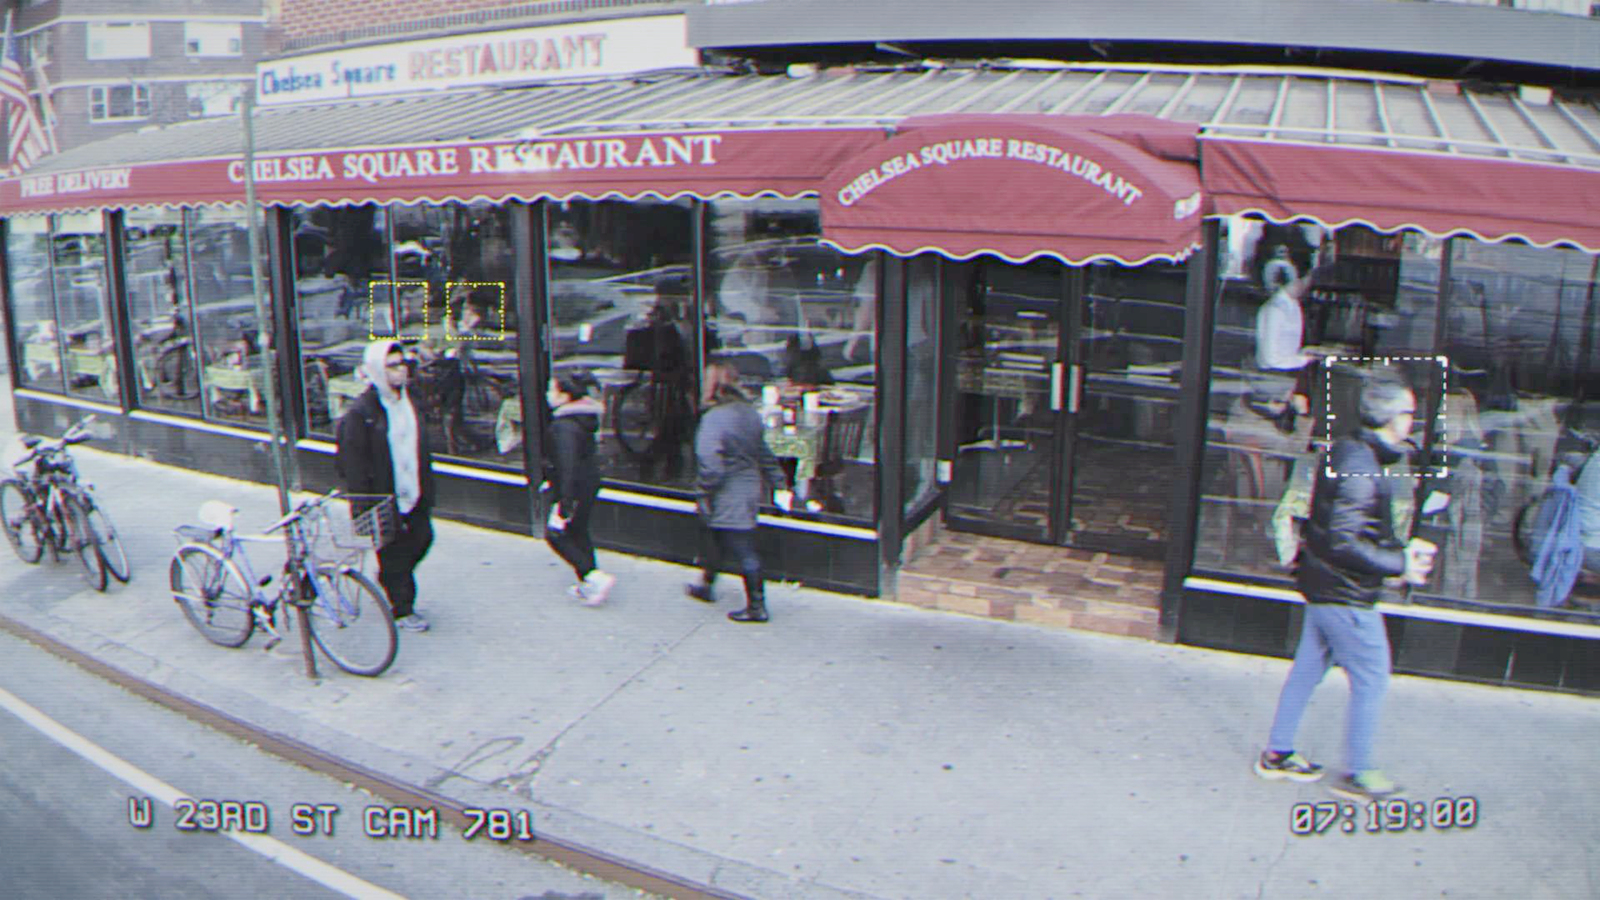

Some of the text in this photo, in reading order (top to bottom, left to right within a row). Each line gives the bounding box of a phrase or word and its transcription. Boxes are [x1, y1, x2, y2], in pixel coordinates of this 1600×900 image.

[261, 34, 607, 98] Chelsea Square RESTAURANT
[20, 167, 132, 198] FREE DELIVERY
[342, 148, 459, 183] SQUARE
[469, 134, 722, 174] RESTAURANT
[837, 152, 921, 207] CHELSEA
[920, 138, 1003, 165] SQUARE
[1006, 138, 1143, 207] RESTAURANT
